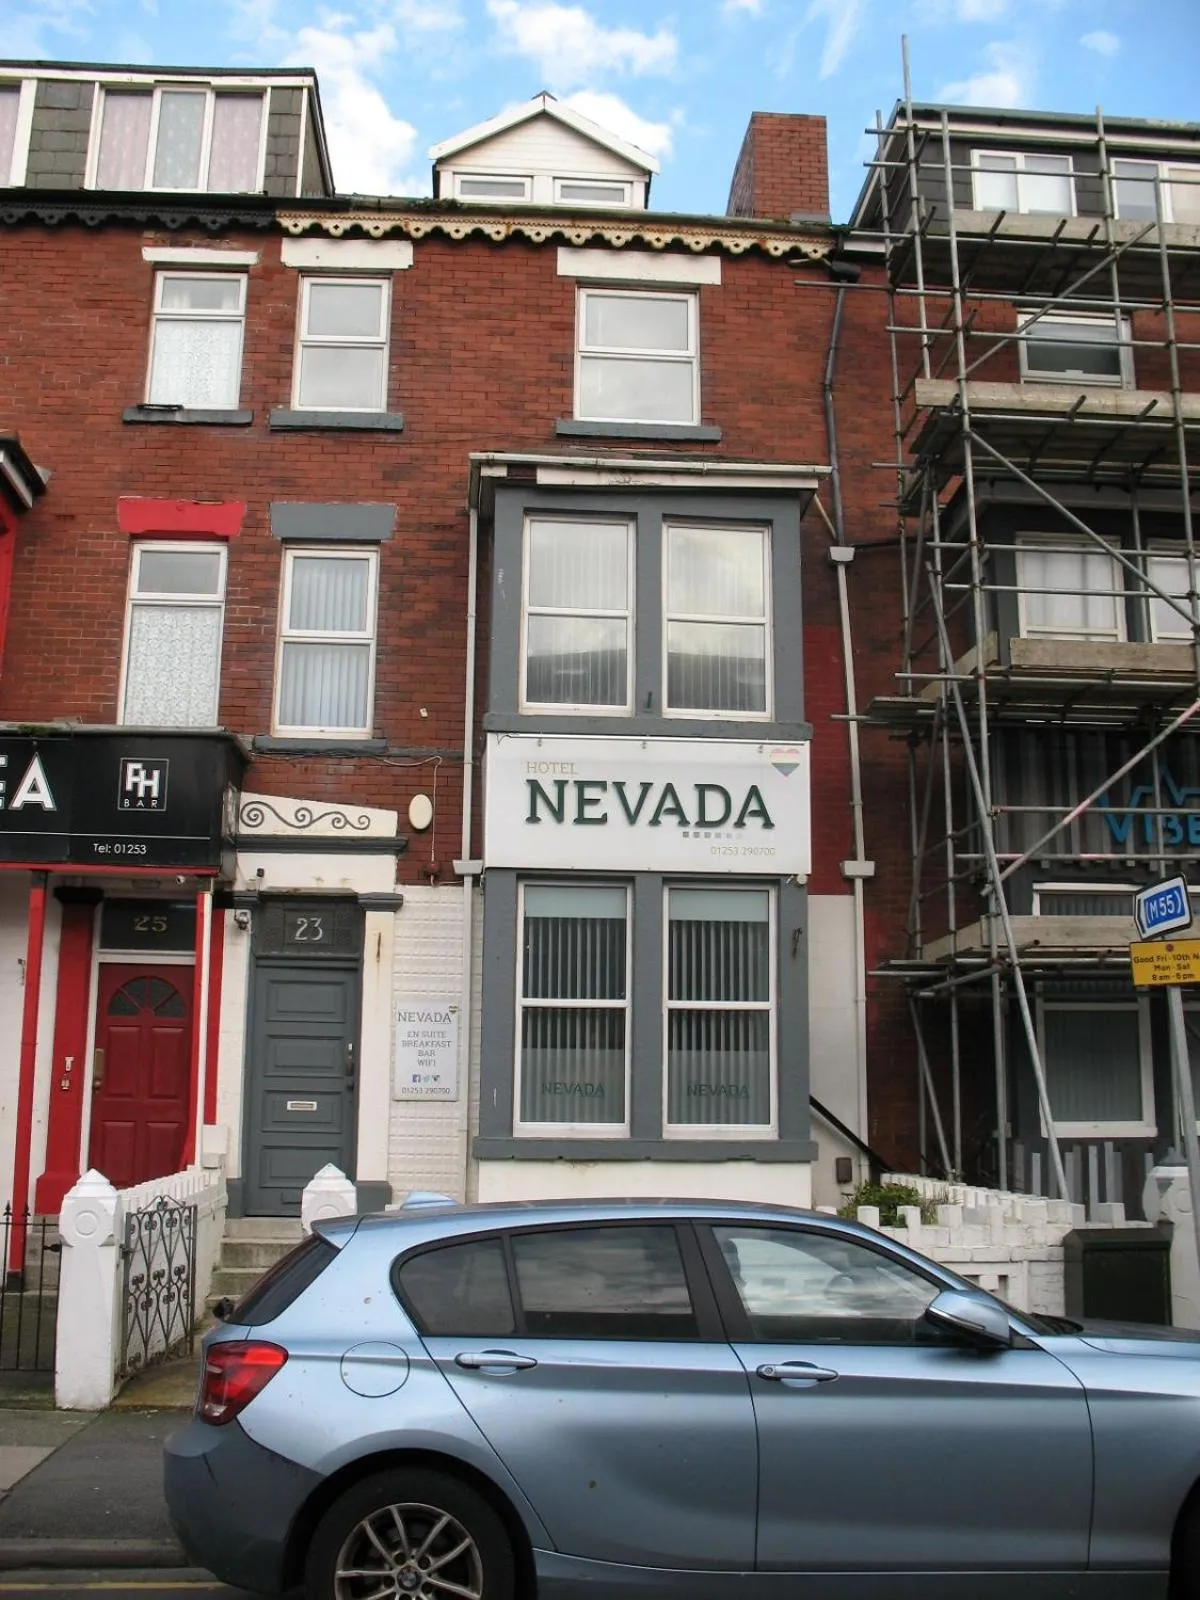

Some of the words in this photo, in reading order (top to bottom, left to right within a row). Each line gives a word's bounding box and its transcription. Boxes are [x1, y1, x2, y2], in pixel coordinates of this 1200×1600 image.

[526, 761, 578, 775] HOTEL
[0, 751, 57, 811] A
[123, 798, 159, 809] BAR
[525, 779, 775, 829] NEVADA
[93, 843, 112, 854] Tel:
[113, 843, 147, 855] 01253
[710, 846, 739, 856] 01253
[134, 916, 167, 932] 25
[295, 918, 323, 940] 23
[1133, 956, 1154, 964] Good
[1156, 954, 1167, 963] Fri
[398, 1011, 452, 1022] NEVADA
[401, 1040, 452, 1048] BREAKFAST
[417, 1049, 436, 1057] BAR
[540, 1081, 605, 1098] NEVADA
[687, 1081, 749, 1099] NEVADA
